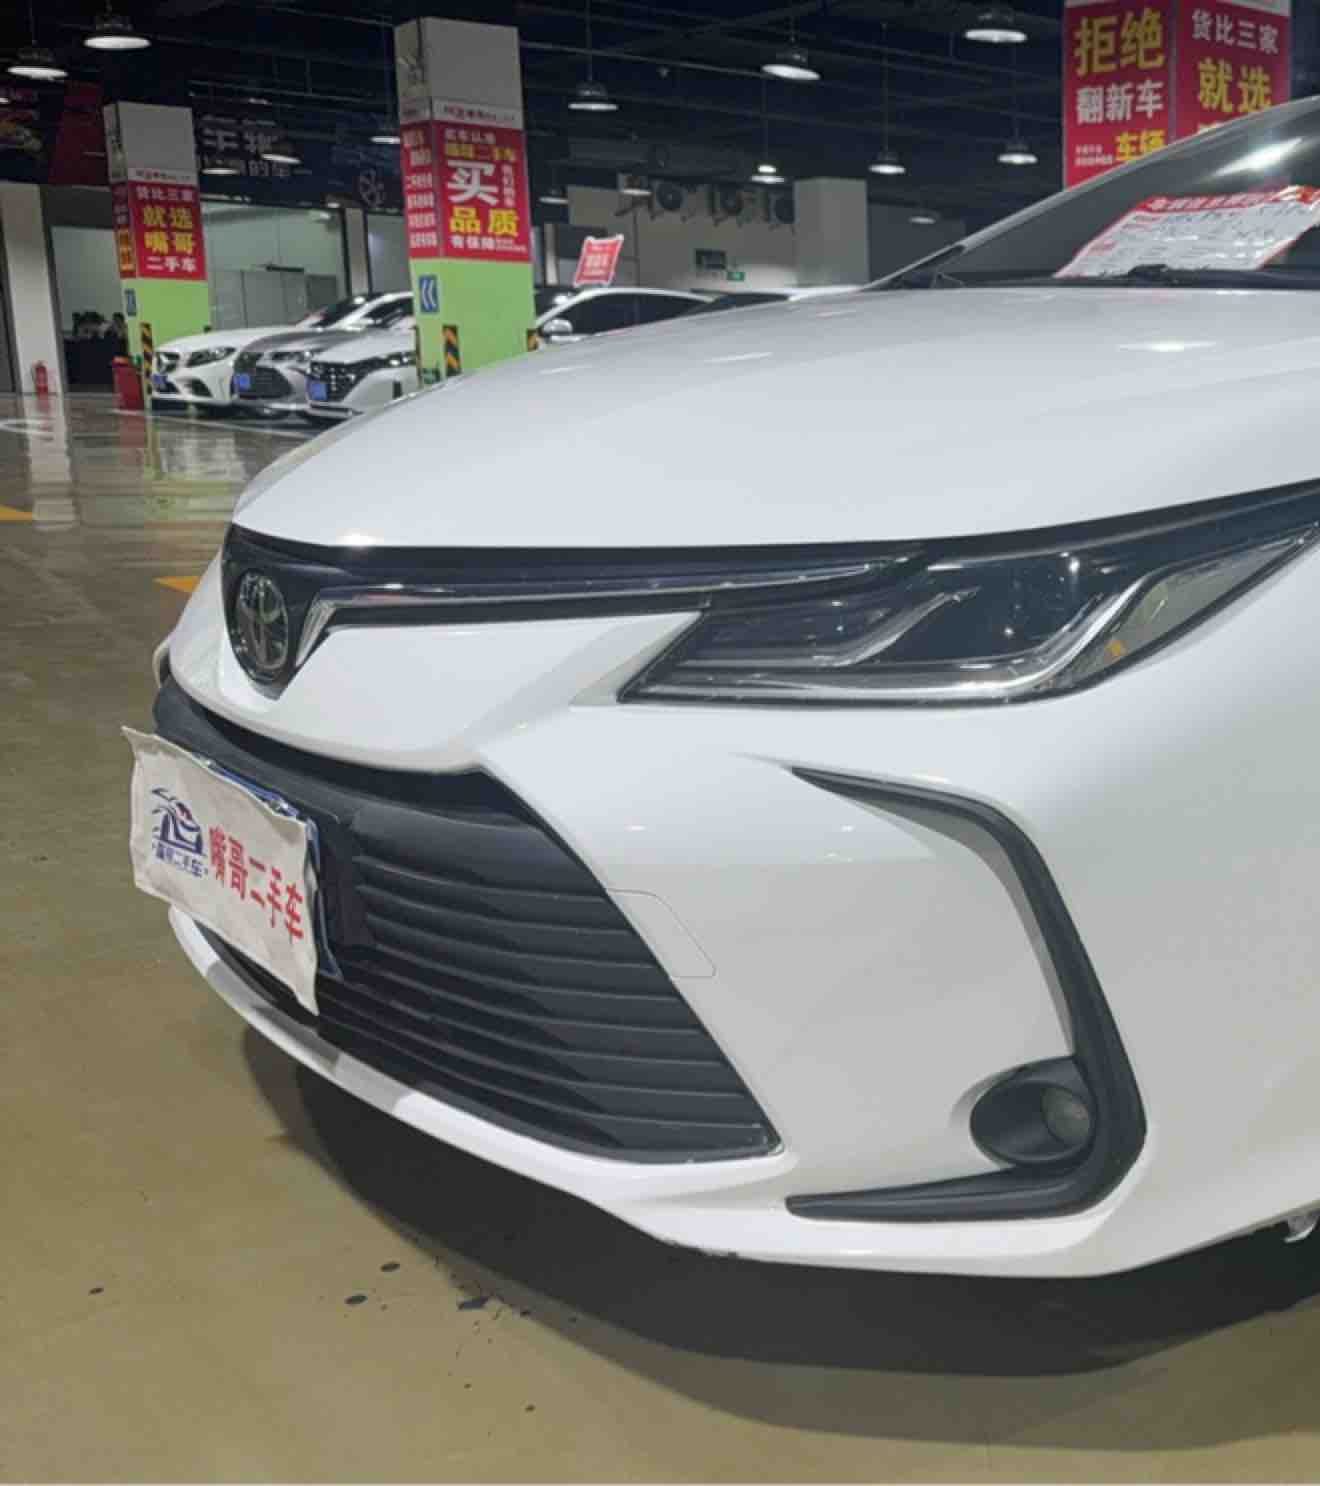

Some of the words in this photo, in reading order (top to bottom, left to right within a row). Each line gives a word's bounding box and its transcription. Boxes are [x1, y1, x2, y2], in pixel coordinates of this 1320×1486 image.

[1073, 8, 1165, 79] 拒绝
[1191, 9, 1279, 55] 货比三家
[1076, 79, 1164, 126] 翻新车
[1197, 57, 1271, 113] 就选
[447, 160, 499, 205] 买
[143, 206, 194, 228] 就选
[450, 206, 519, 237] 品质
[146, 256, 197, 272] 二手车
[209, 823, 304, 945] 嘴哥二手车
